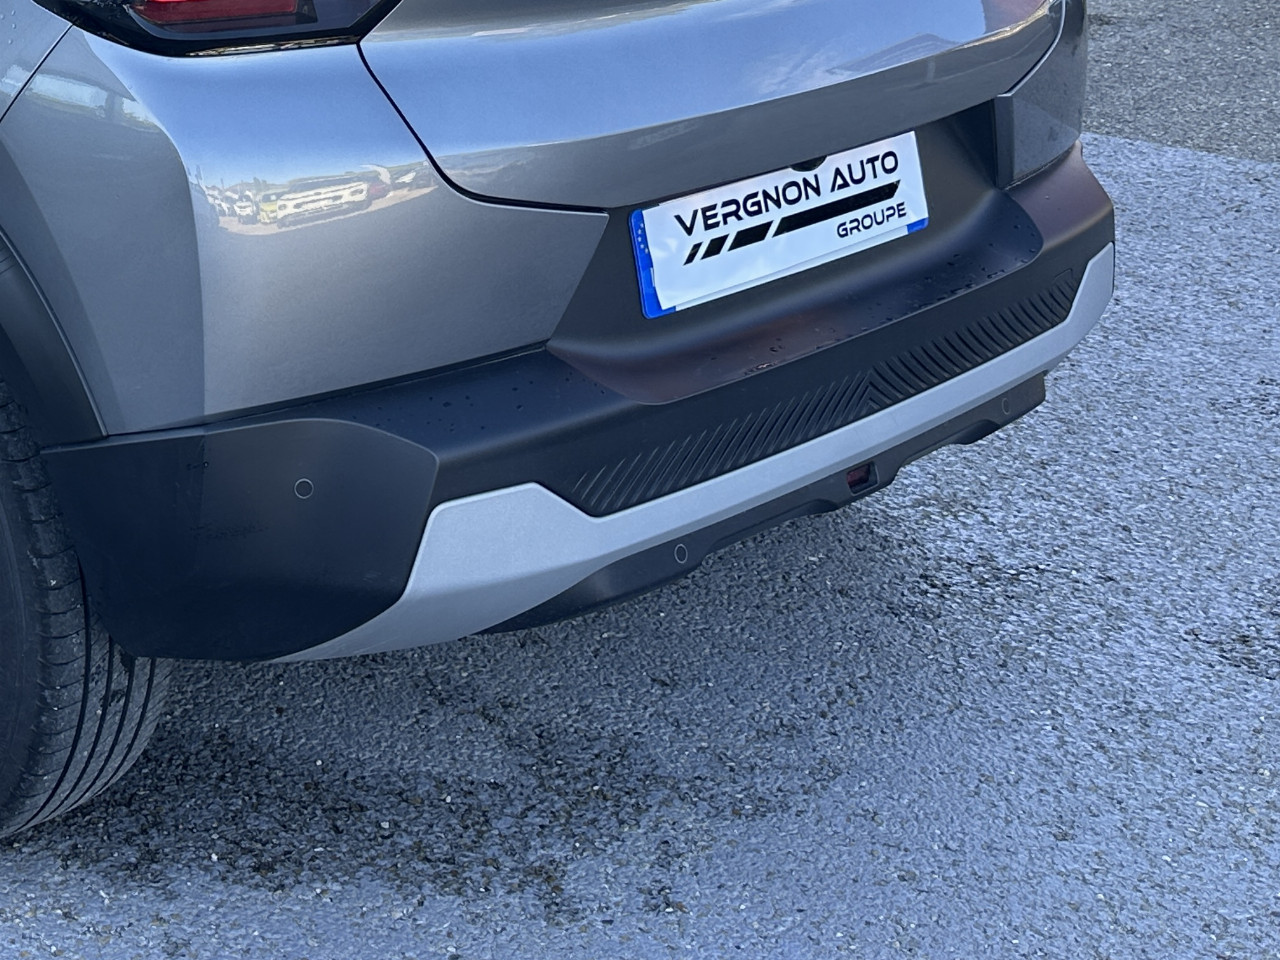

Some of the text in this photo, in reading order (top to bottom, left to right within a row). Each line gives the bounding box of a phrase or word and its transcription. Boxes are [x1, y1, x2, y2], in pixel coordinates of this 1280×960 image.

[674, 150, 899, 236] VERGNON AUTO
[836, 201, 906, 239] GROUPE
